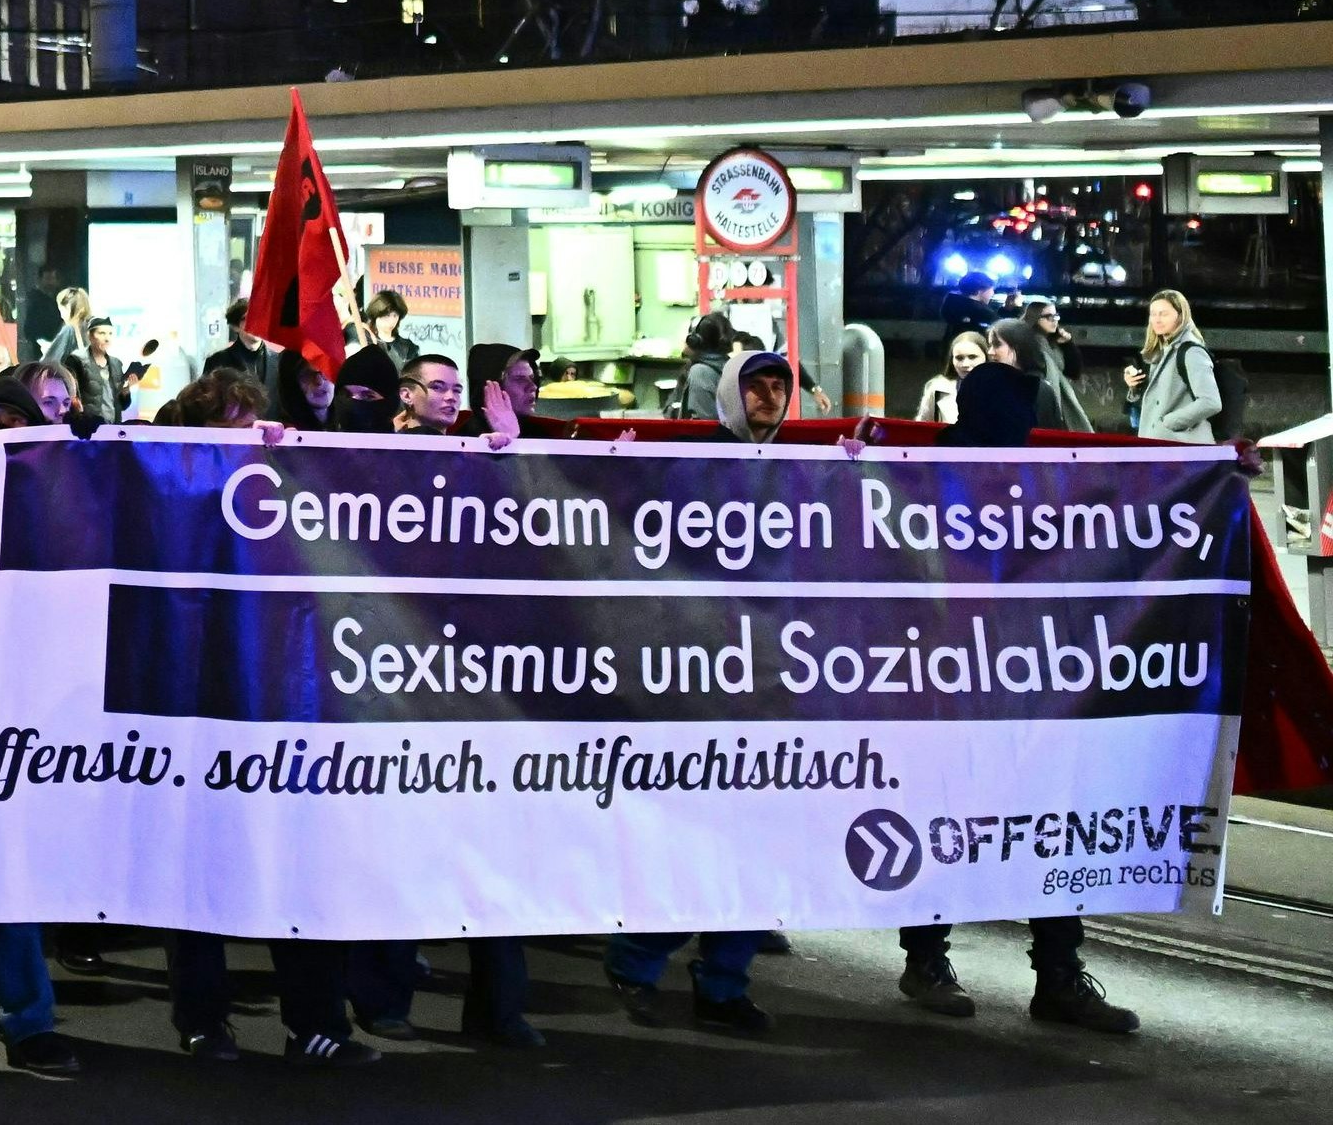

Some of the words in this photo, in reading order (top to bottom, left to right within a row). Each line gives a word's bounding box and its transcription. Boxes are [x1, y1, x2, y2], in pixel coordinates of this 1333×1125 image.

[195, 165, 230, 176] ISLAND
[712, 163, 783, 196] STRASSENBAHN
[714, 210, 780, 239] HALTESTELLE
[379, 260, 425, 275] HEISSE
[220, 462, 610, 548] Gemeinsam
[633, 498, 834, 571] gegen
[861, 478, 1215, 561] Rassismus,
[330, 616, 618, 694] Sexismus
[641, 615, 754, 693] und
[779, 614, 1209, 695] Sozialabbau
[205, 737, 498, 795] solidarisch.
[512, 734, 901, 810] antifaschistisch.
[1042, 867, 1112, 895] gegen
[1118, 858, 1217, 887] rechts
